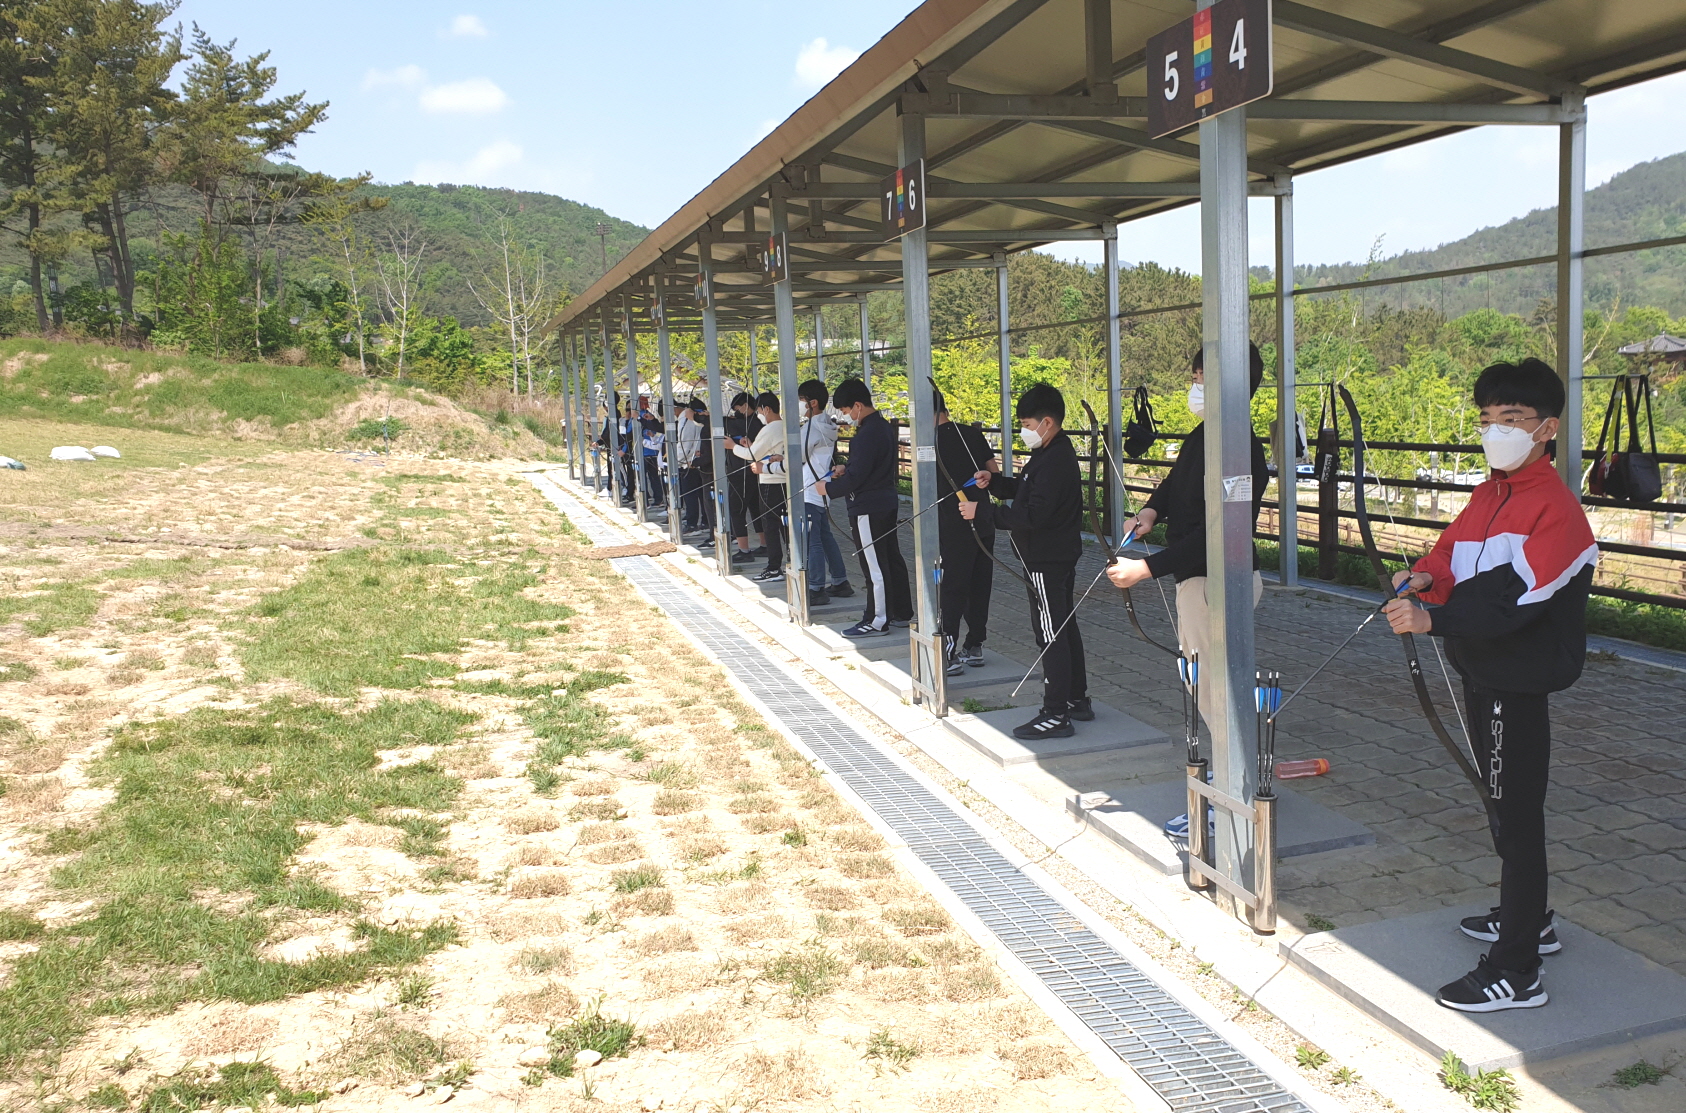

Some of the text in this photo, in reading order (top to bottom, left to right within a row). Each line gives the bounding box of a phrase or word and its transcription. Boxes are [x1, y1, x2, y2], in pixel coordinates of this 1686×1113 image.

[1164, 50, 1180, 101] 5
[1229, 18, 1248, 70] 4
[886, 179, 916, 221] 7 6
[763, 245, 782, 272] 9 8
[1489, 719, 1504, 800] SPYDER
